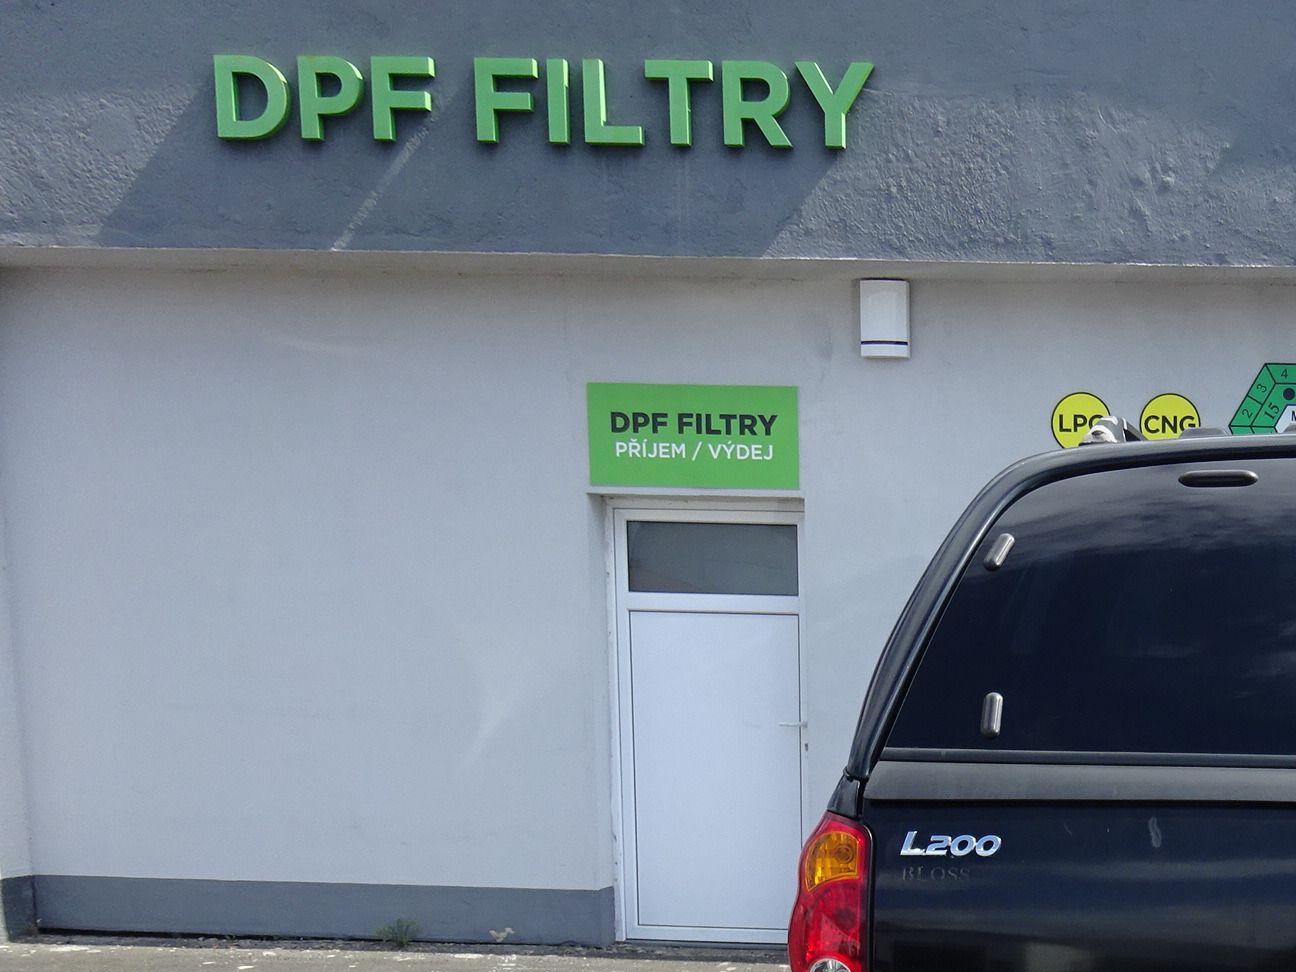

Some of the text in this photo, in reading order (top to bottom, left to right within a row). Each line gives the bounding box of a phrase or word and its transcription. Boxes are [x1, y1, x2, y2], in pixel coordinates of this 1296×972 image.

[213, 54, 875, 150] DPF FILTRY
[1280, 368, 1289, 380] 4
[1256, 383, 1267, 393] 3
[1241, 408, 1253, 418] 2
[1264, 402, 1280, 420] 15
[610, 411, 778, 436] DPF FILTRY
[1144, 415, 1196, 434] CNG
[615, 438, 774, 462] PŘÍJEM / VÝDEJ
[900, 830, 1002, 857] L200
